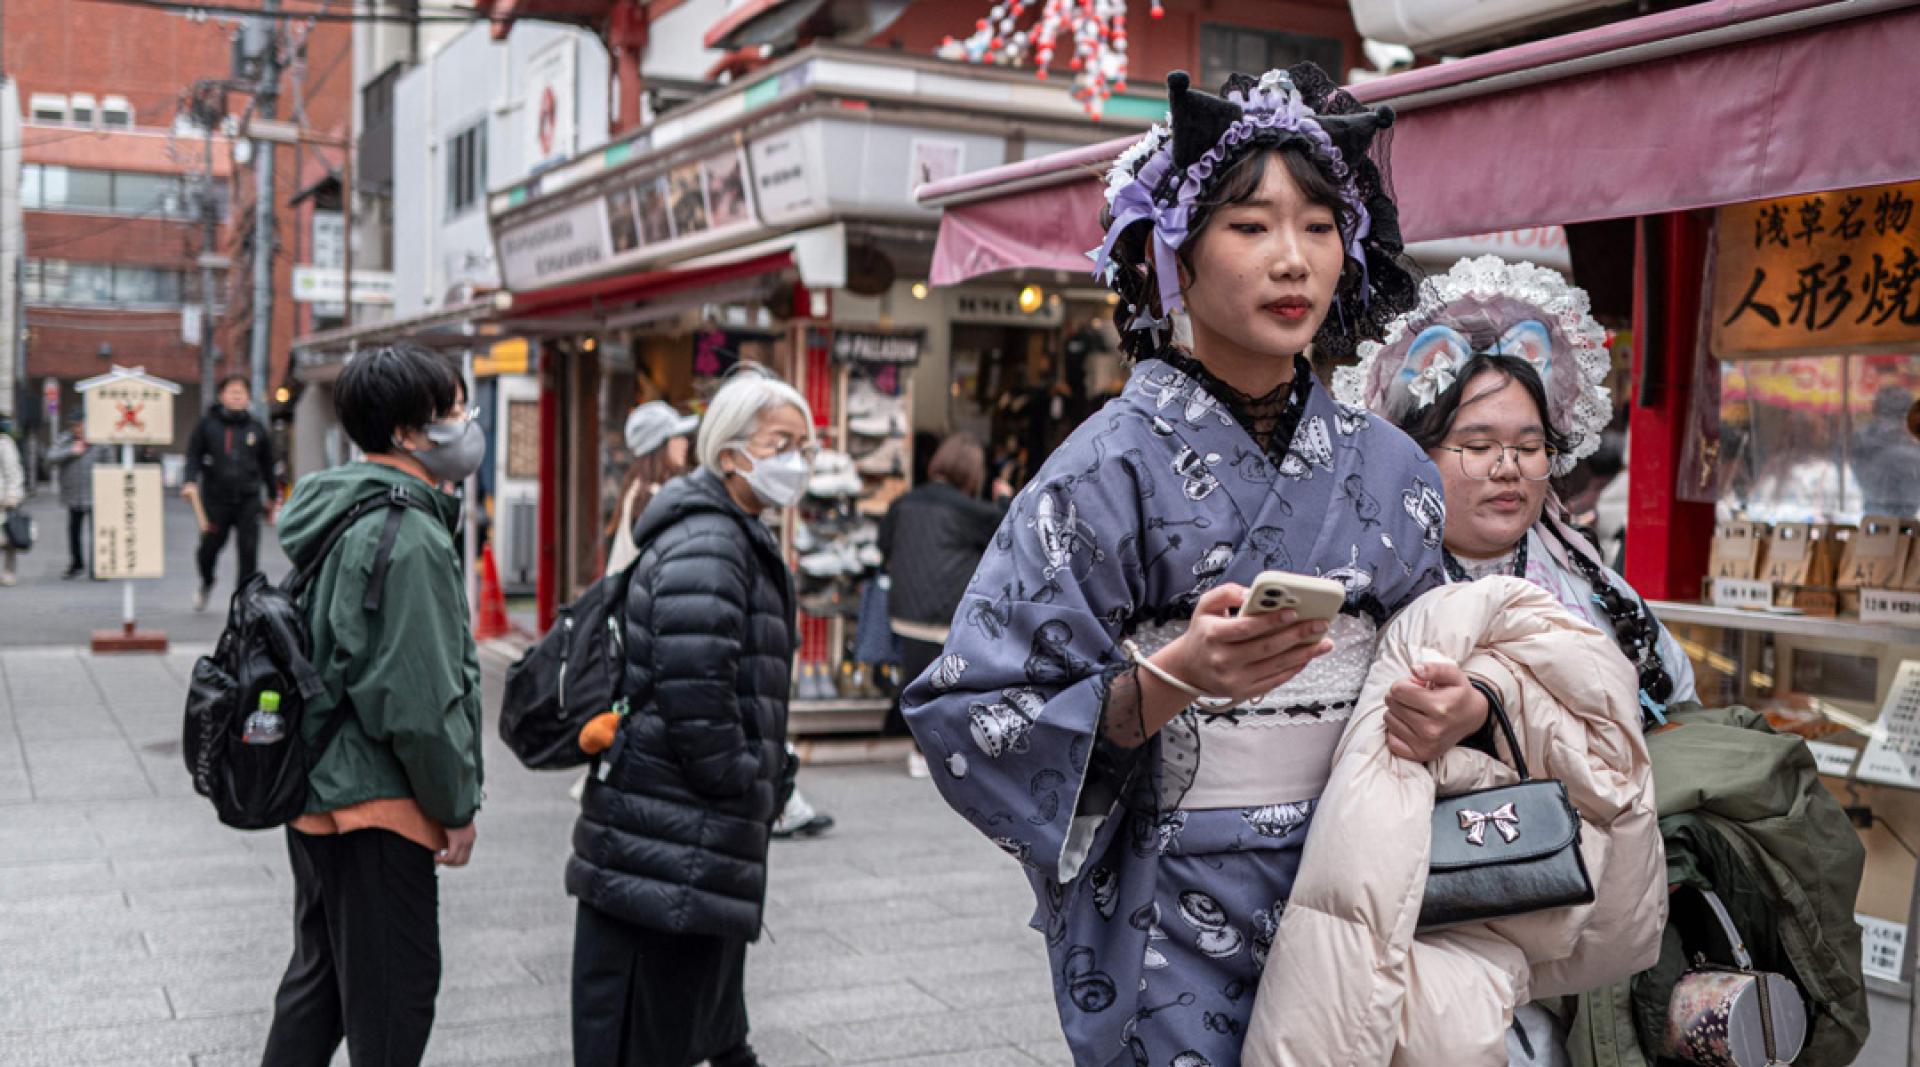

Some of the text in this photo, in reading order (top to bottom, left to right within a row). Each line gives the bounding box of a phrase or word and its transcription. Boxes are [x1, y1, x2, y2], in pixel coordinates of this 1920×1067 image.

[1755, 191, 1913, 248] 浅草名物
[1723, 247, 1920, 331] 人形焼
